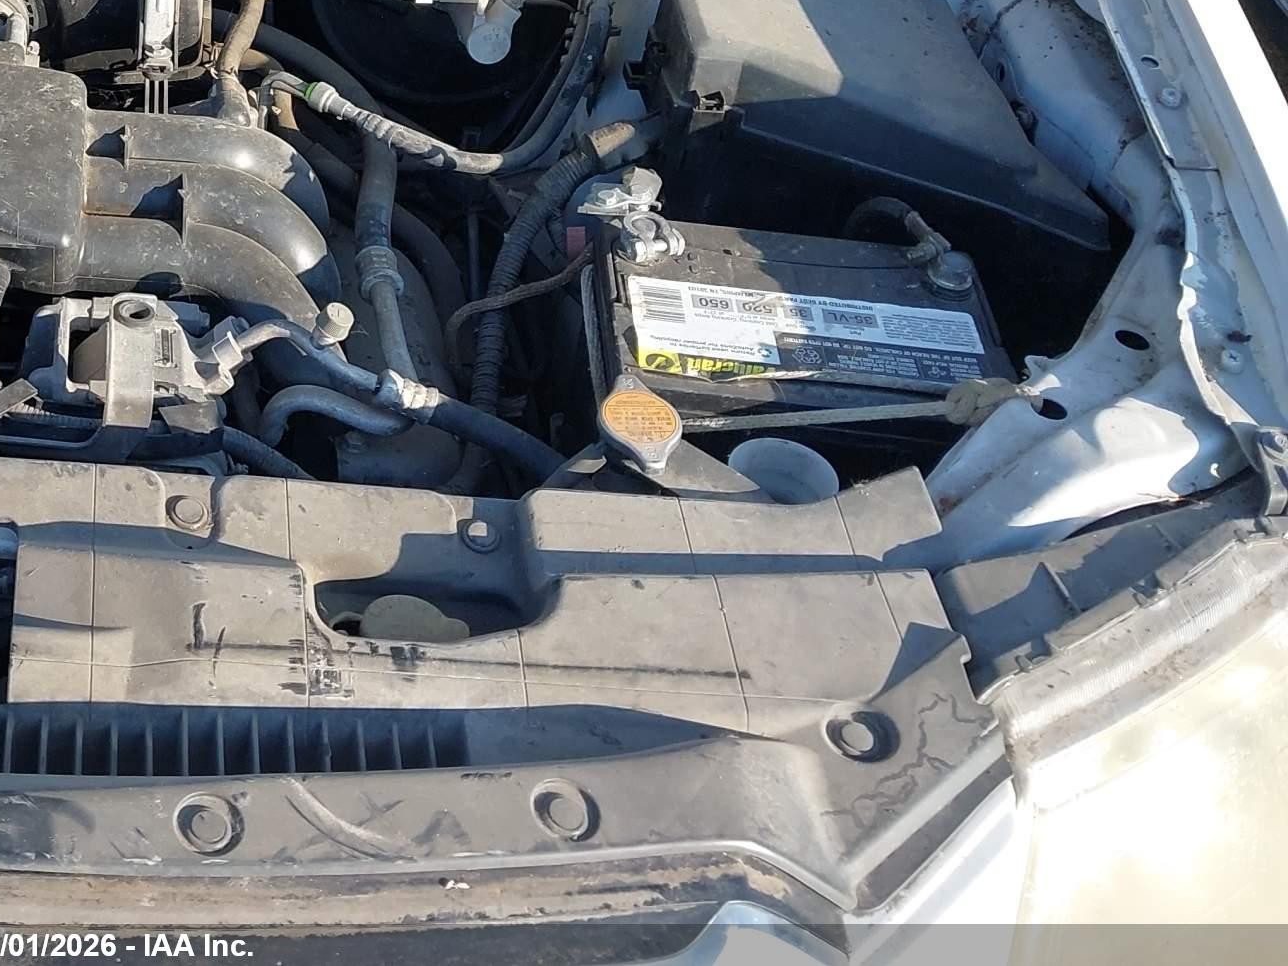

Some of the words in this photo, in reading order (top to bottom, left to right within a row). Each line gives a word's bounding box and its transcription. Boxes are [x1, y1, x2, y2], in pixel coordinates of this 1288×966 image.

[698, 297, 730, 310] 650
[741, 302, 773, 315] 520
[788, 308, 807, 318] 35
[827, 311, 874, 326] 35-VL
